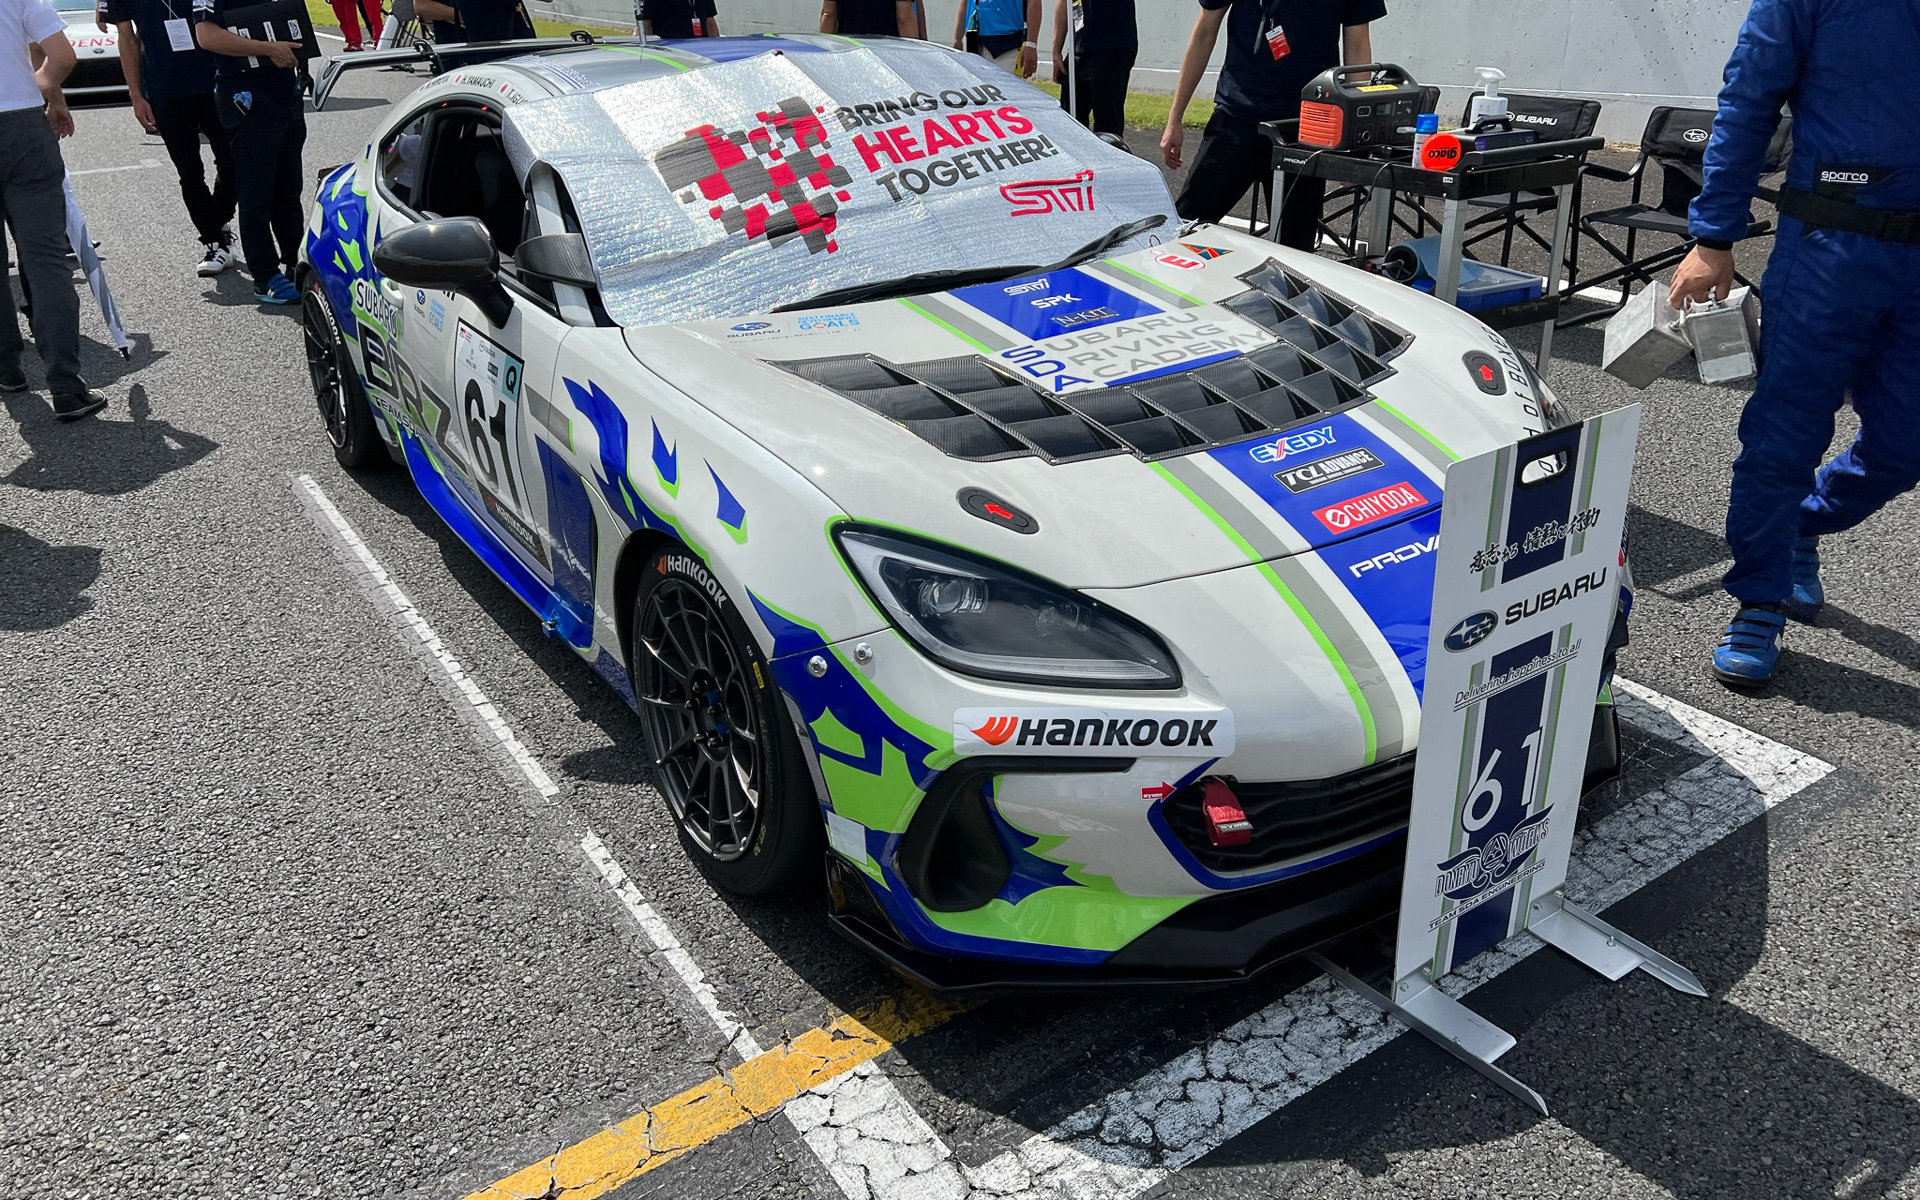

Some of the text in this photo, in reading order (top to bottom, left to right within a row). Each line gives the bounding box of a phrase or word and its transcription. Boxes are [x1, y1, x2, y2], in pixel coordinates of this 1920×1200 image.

[836, 83, 1008, 132] BRING OUR
[1515, 114, 1558, 126] SUBARU
[851, 105, 1034, 173] HEARTS
[876, 134, 1060, 203] TOGETHER!
[1820, 170, 1869, 182] sparco
[356, 281, 398, 338] SUBARU
[799, 319, 860, 330] GOALS
[1030, 293, 1082, 309] SPK
[726, 329, 780, 338] SUBARU
[358, 320, 470, 477] BRZ
[506, 365, 518, 394] Q
[464, 378, 527, 522] 61
[1249, 426, 1337, 463] EXEDY
[1281, 468, 1324, 487] TCL
[1319, 450, 1375, 475] ADVANCE
[1343, 486, 1420, 521] CHIYODA
[1523, 507, 1602, 552] 情熱と行動
[1505, 566, 1607, 626] SUBARU
[1455, 638, 1582, 705] Delivering happiness to all
[1461, 726, 1544, 832] 61
[1428, 862, 1546, 930] TEAM SDA ENGINEERING
